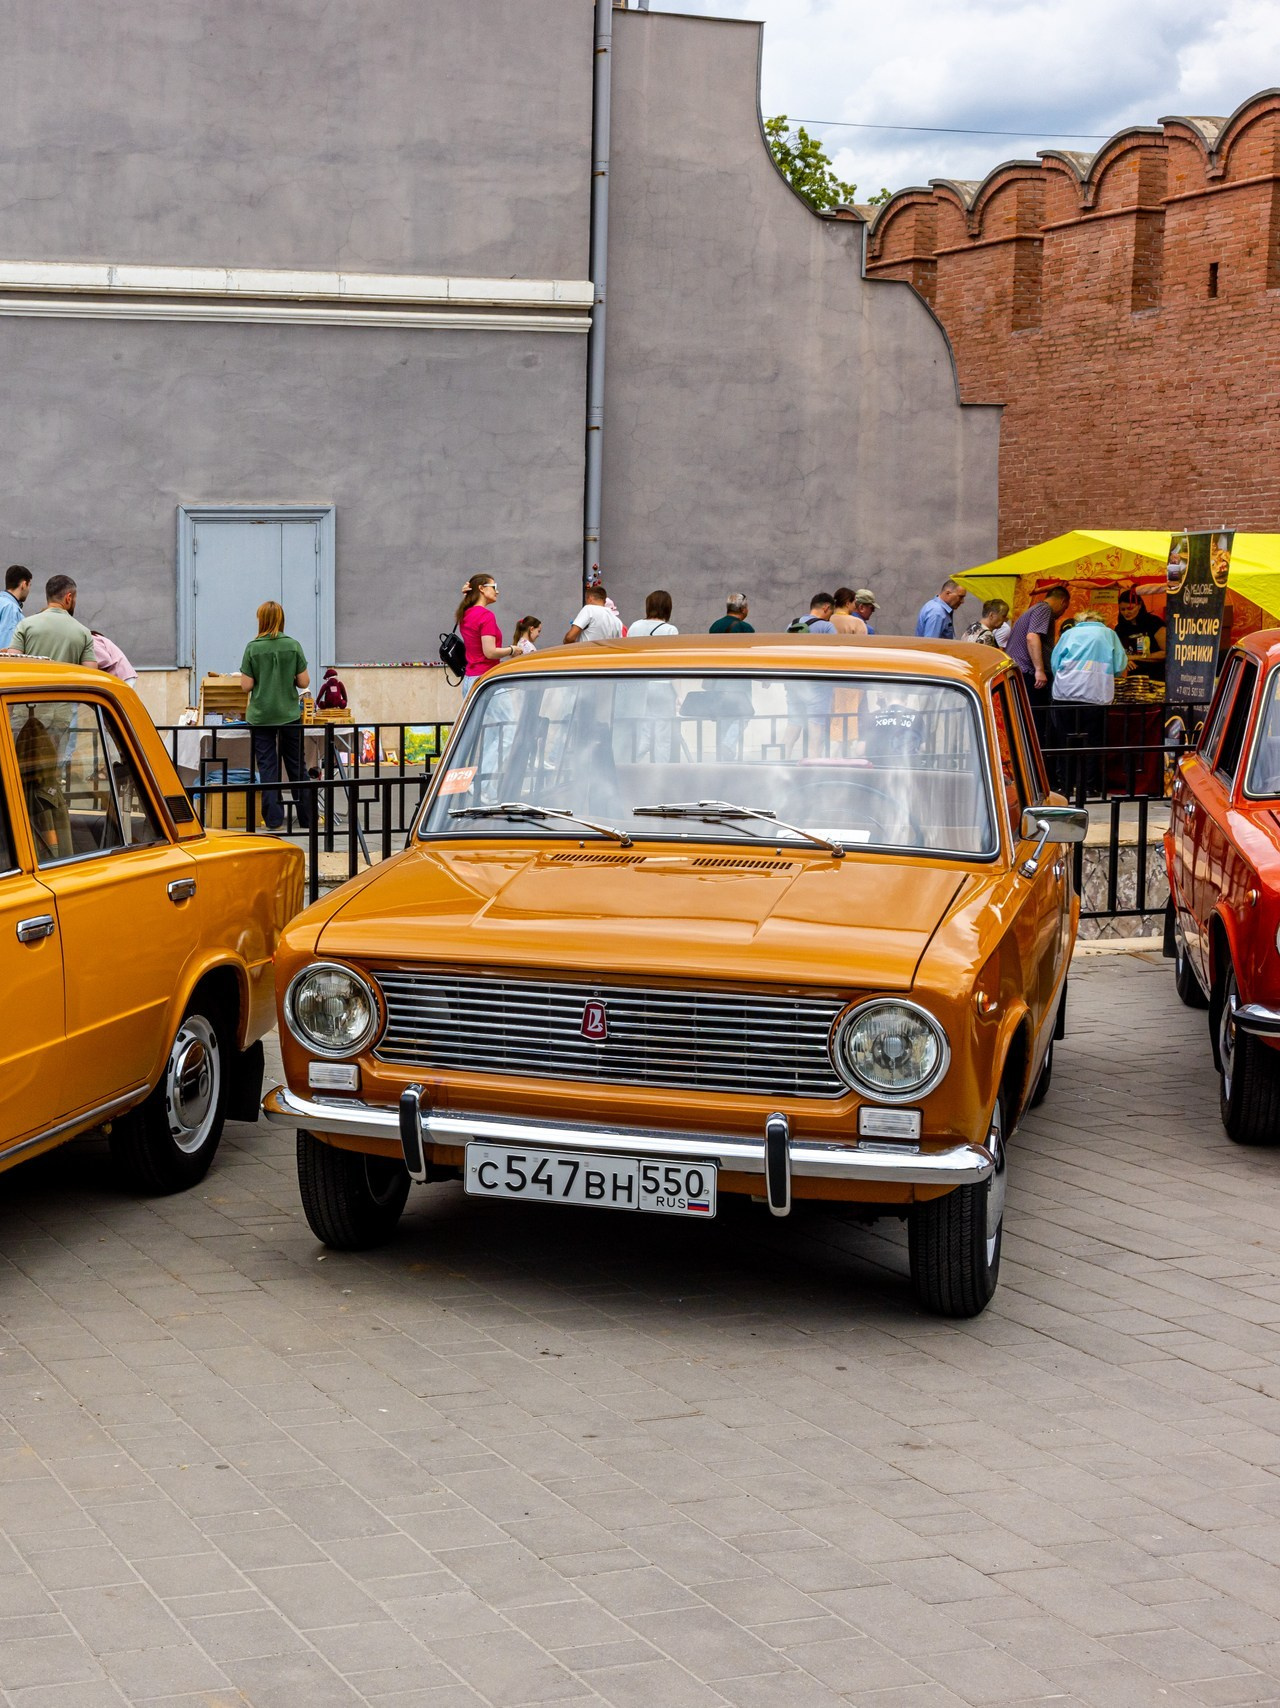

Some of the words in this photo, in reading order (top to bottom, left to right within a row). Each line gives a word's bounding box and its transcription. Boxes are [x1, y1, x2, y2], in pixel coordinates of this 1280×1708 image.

[1173, 613, 1220, 641] Тульские
[1174, 644, 1213, 667] пряники
[445, 770, 473, 782] 1979
[641, 1164, 704, 1198] 550
[656, 1195, 686, 1209] RUS
